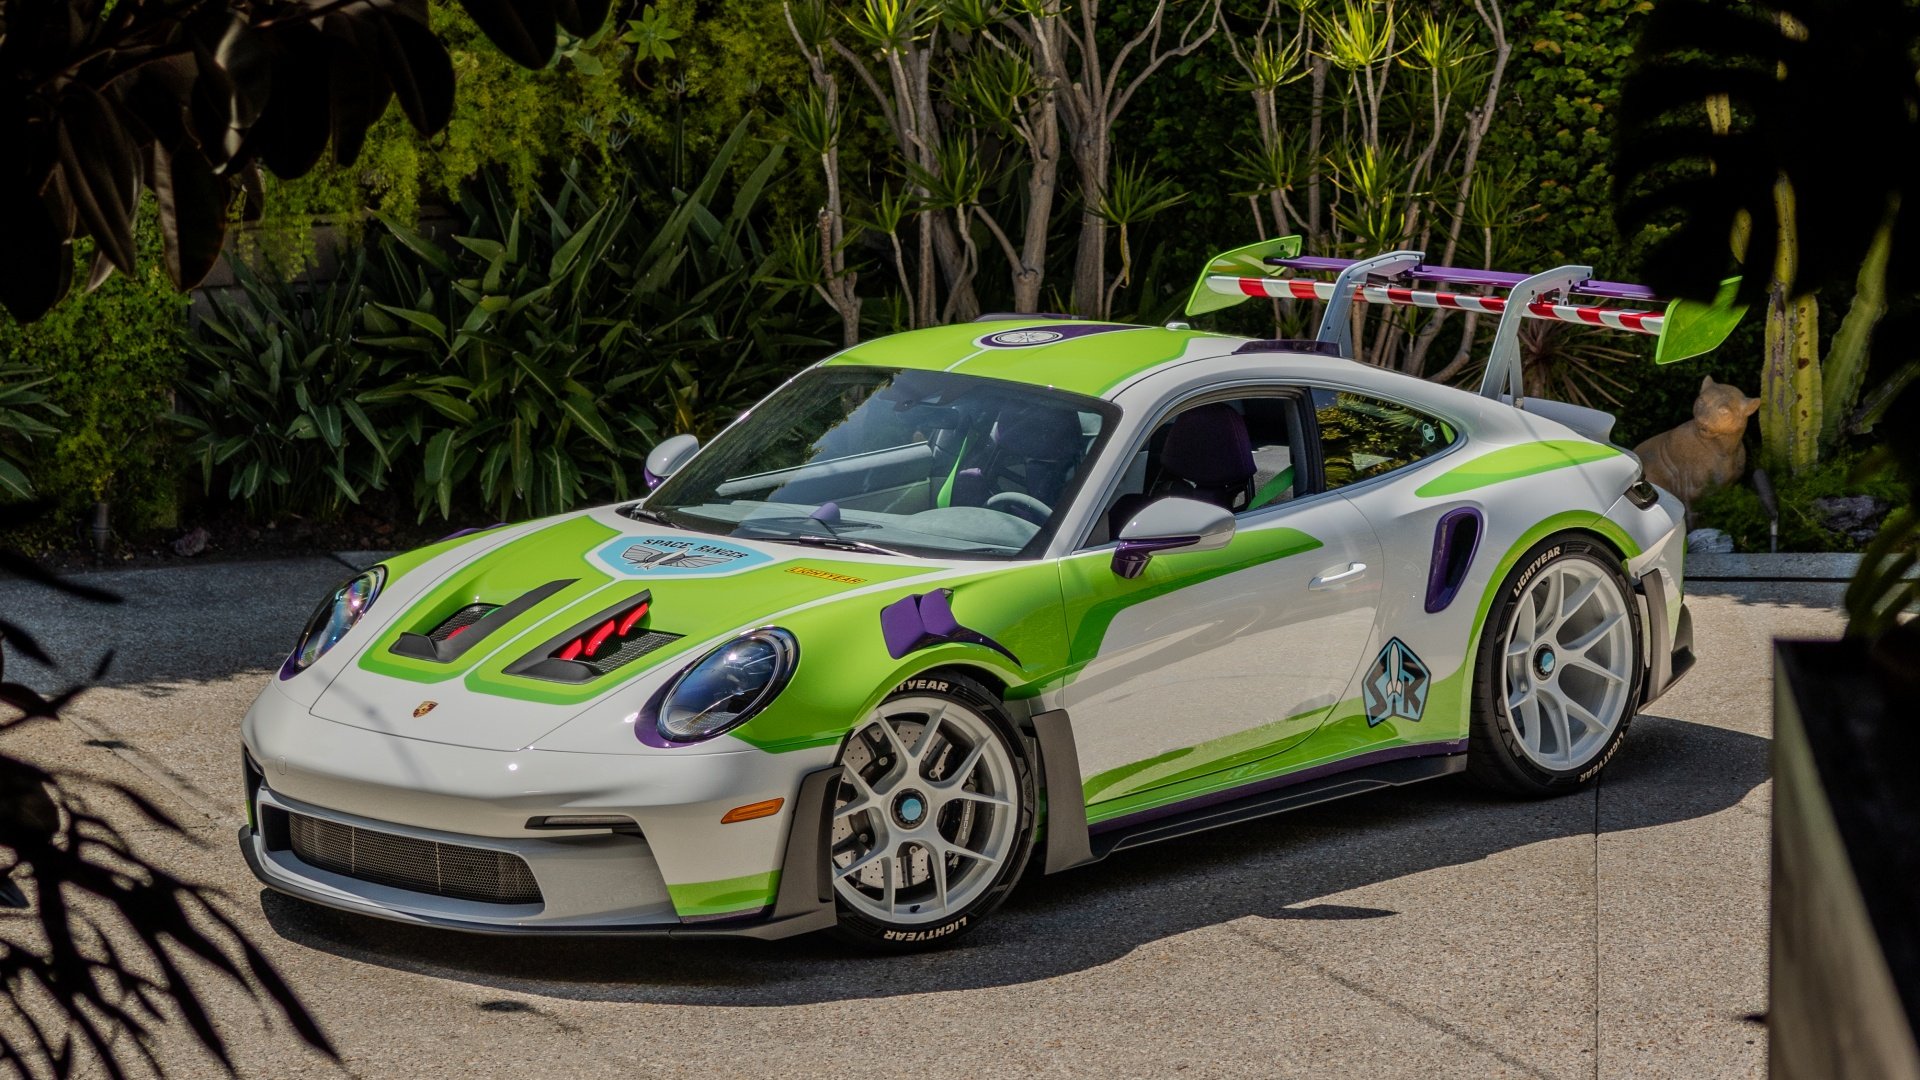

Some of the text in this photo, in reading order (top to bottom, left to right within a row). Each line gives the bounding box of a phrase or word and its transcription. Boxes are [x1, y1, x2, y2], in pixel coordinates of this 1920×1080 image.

[643, 539, 748, 558] SPACE RANGER
[1513, 546, 1560, 597] LIGHTYEAR
[893, 679, 949, 692] TYEAR
[1580, 731, 1624, 782] LIGHTYEAR
[883, 916, 967, 942] LIGHTYEAR
